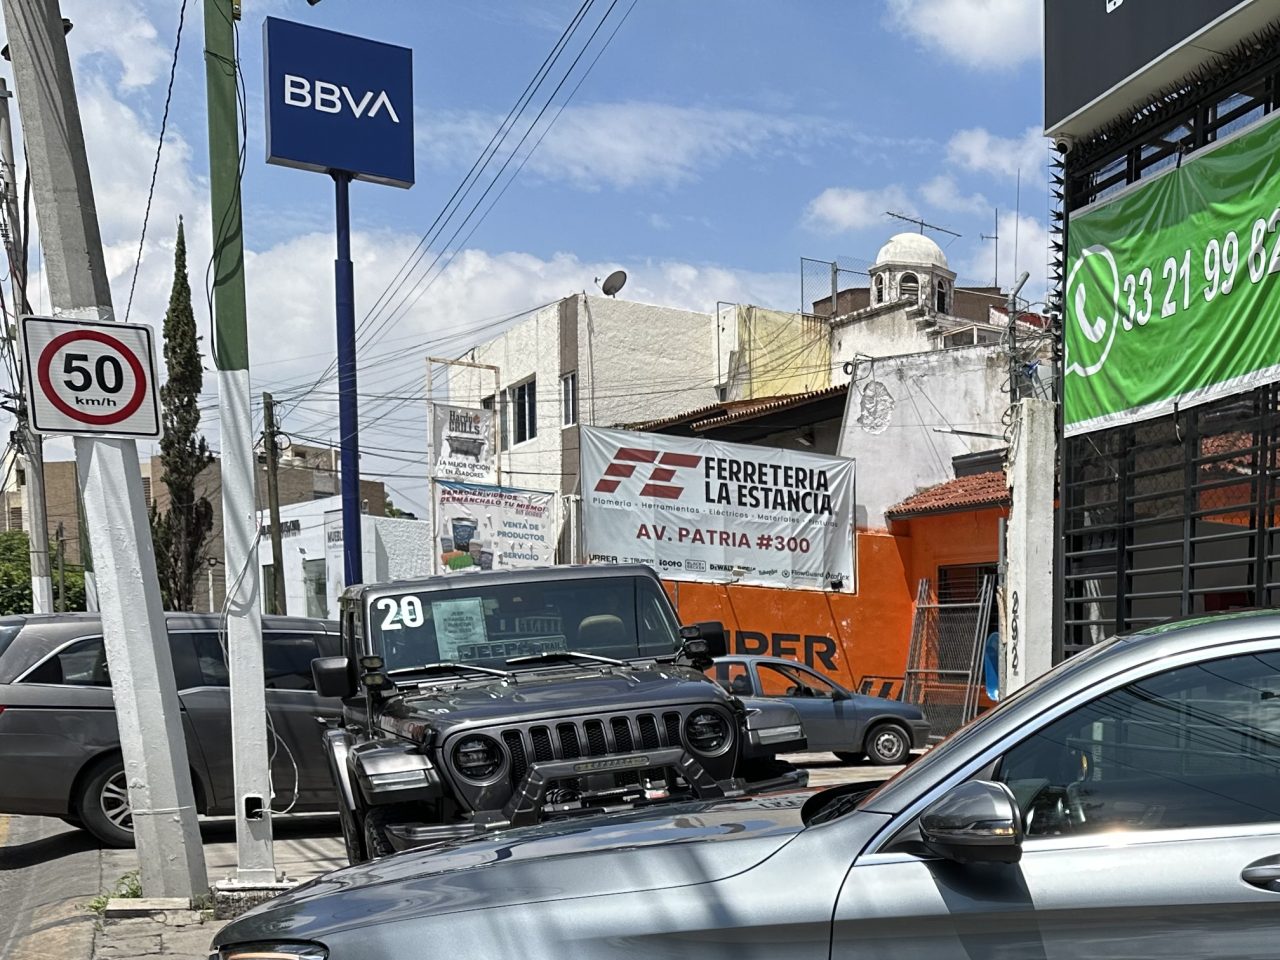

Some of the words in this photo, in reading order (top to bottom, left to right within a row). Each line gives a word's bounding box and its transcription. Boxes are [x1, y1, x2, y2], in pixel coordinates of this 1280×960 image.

[284, 73, 400, 123] BBVA
[1122, 267, 1152, 331] 33
[1161, 249, 1192, 319] 21
[1202, 230, 1240, 302] 99
[63, 352, 124, 394] 50
[75, 396, 117, 407] km/h
[704, 456, 829, 492] FERRETERIA
[641, 502, 700, 514] Herramientas
[704, 481, 732, 505] LA
[737, 484, 833, 516] ESTANCIA
[497, 530, 545, 542] PRODUCTOS
[502, 520, 528, 530] VENTA
[529, 522, 540, 531] DE
[636, 523, 673, 542] AV.
[678, 528, 751, 548] PATRIA
[756, 533, 811, 553] #300
[503, 551, 540, 561] SERVICIO
[377, 595, 425, 631] 20
